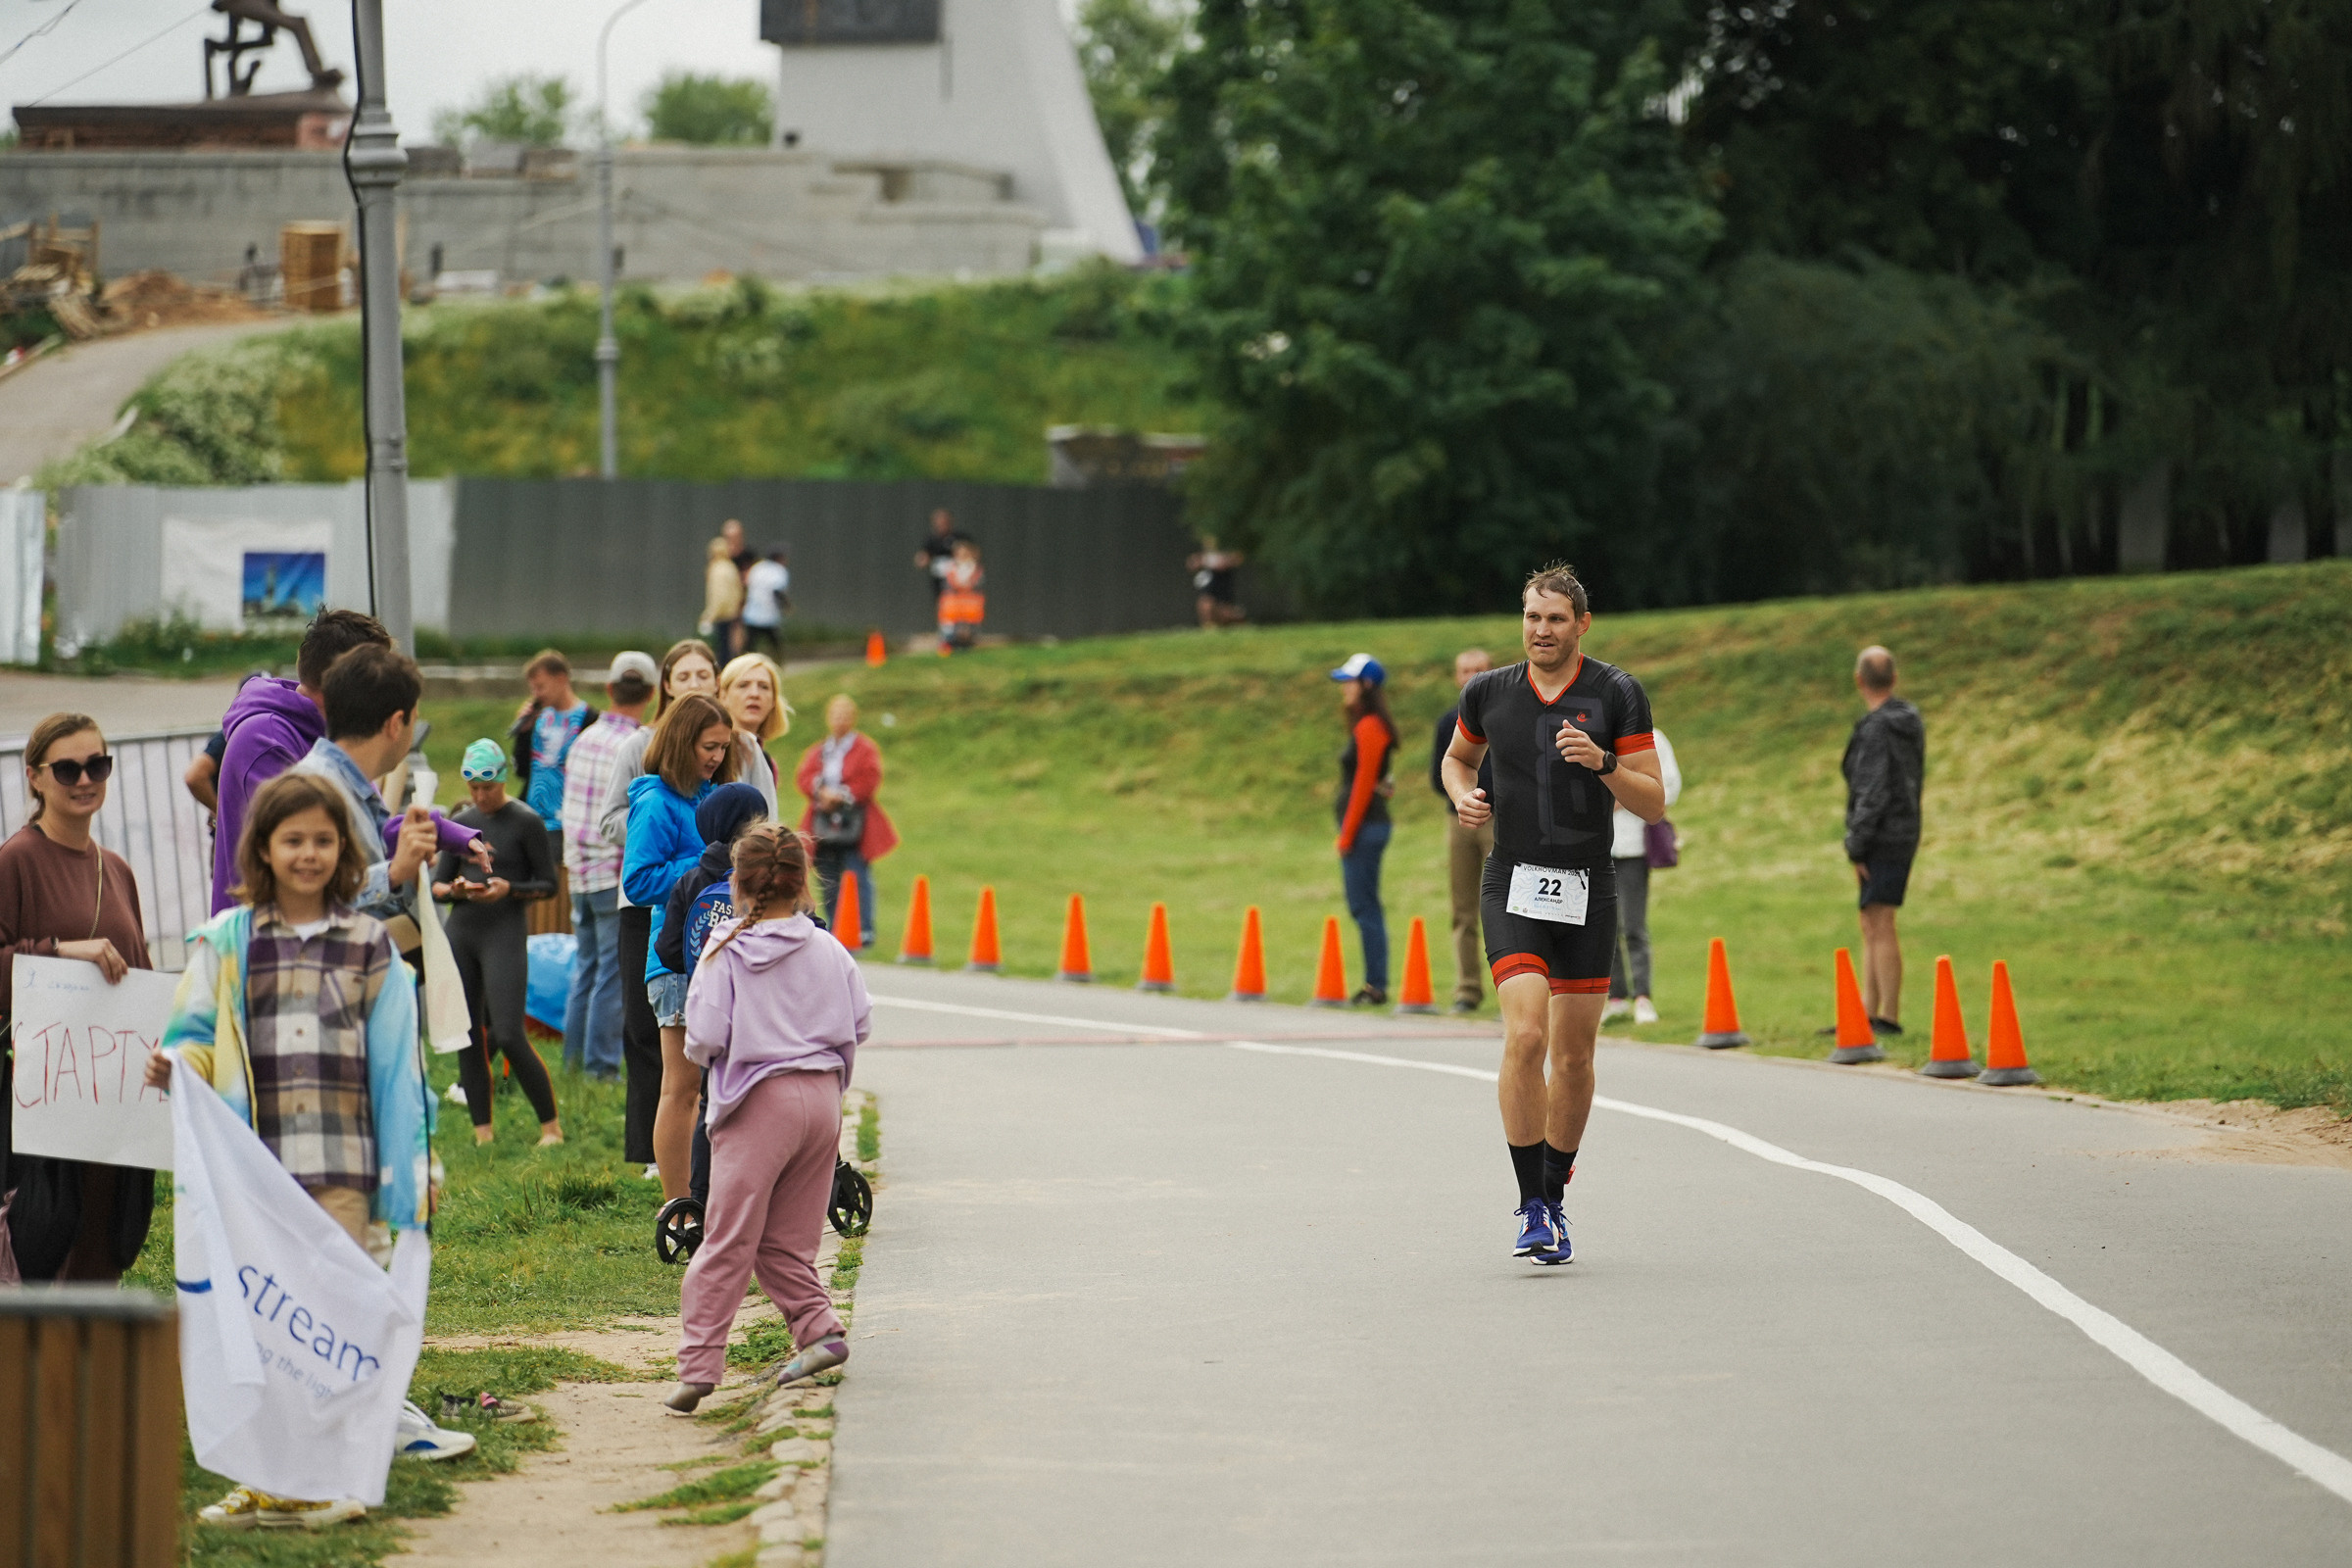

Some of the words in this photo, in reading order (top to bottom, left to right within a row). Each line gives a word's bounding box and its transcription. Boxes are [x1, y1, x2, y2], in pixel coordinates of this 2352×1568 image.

[1523, 865, 1566, 875] VOLKHOVMAN
[1568, 868, 1581, 877] 202
[1538, 878, 1562, 897] 22
[712, 900, 736, 916] FAS
[12, 1020, 170, 1109] СТАРТУ
[276, 1355, 305, 1381] the
